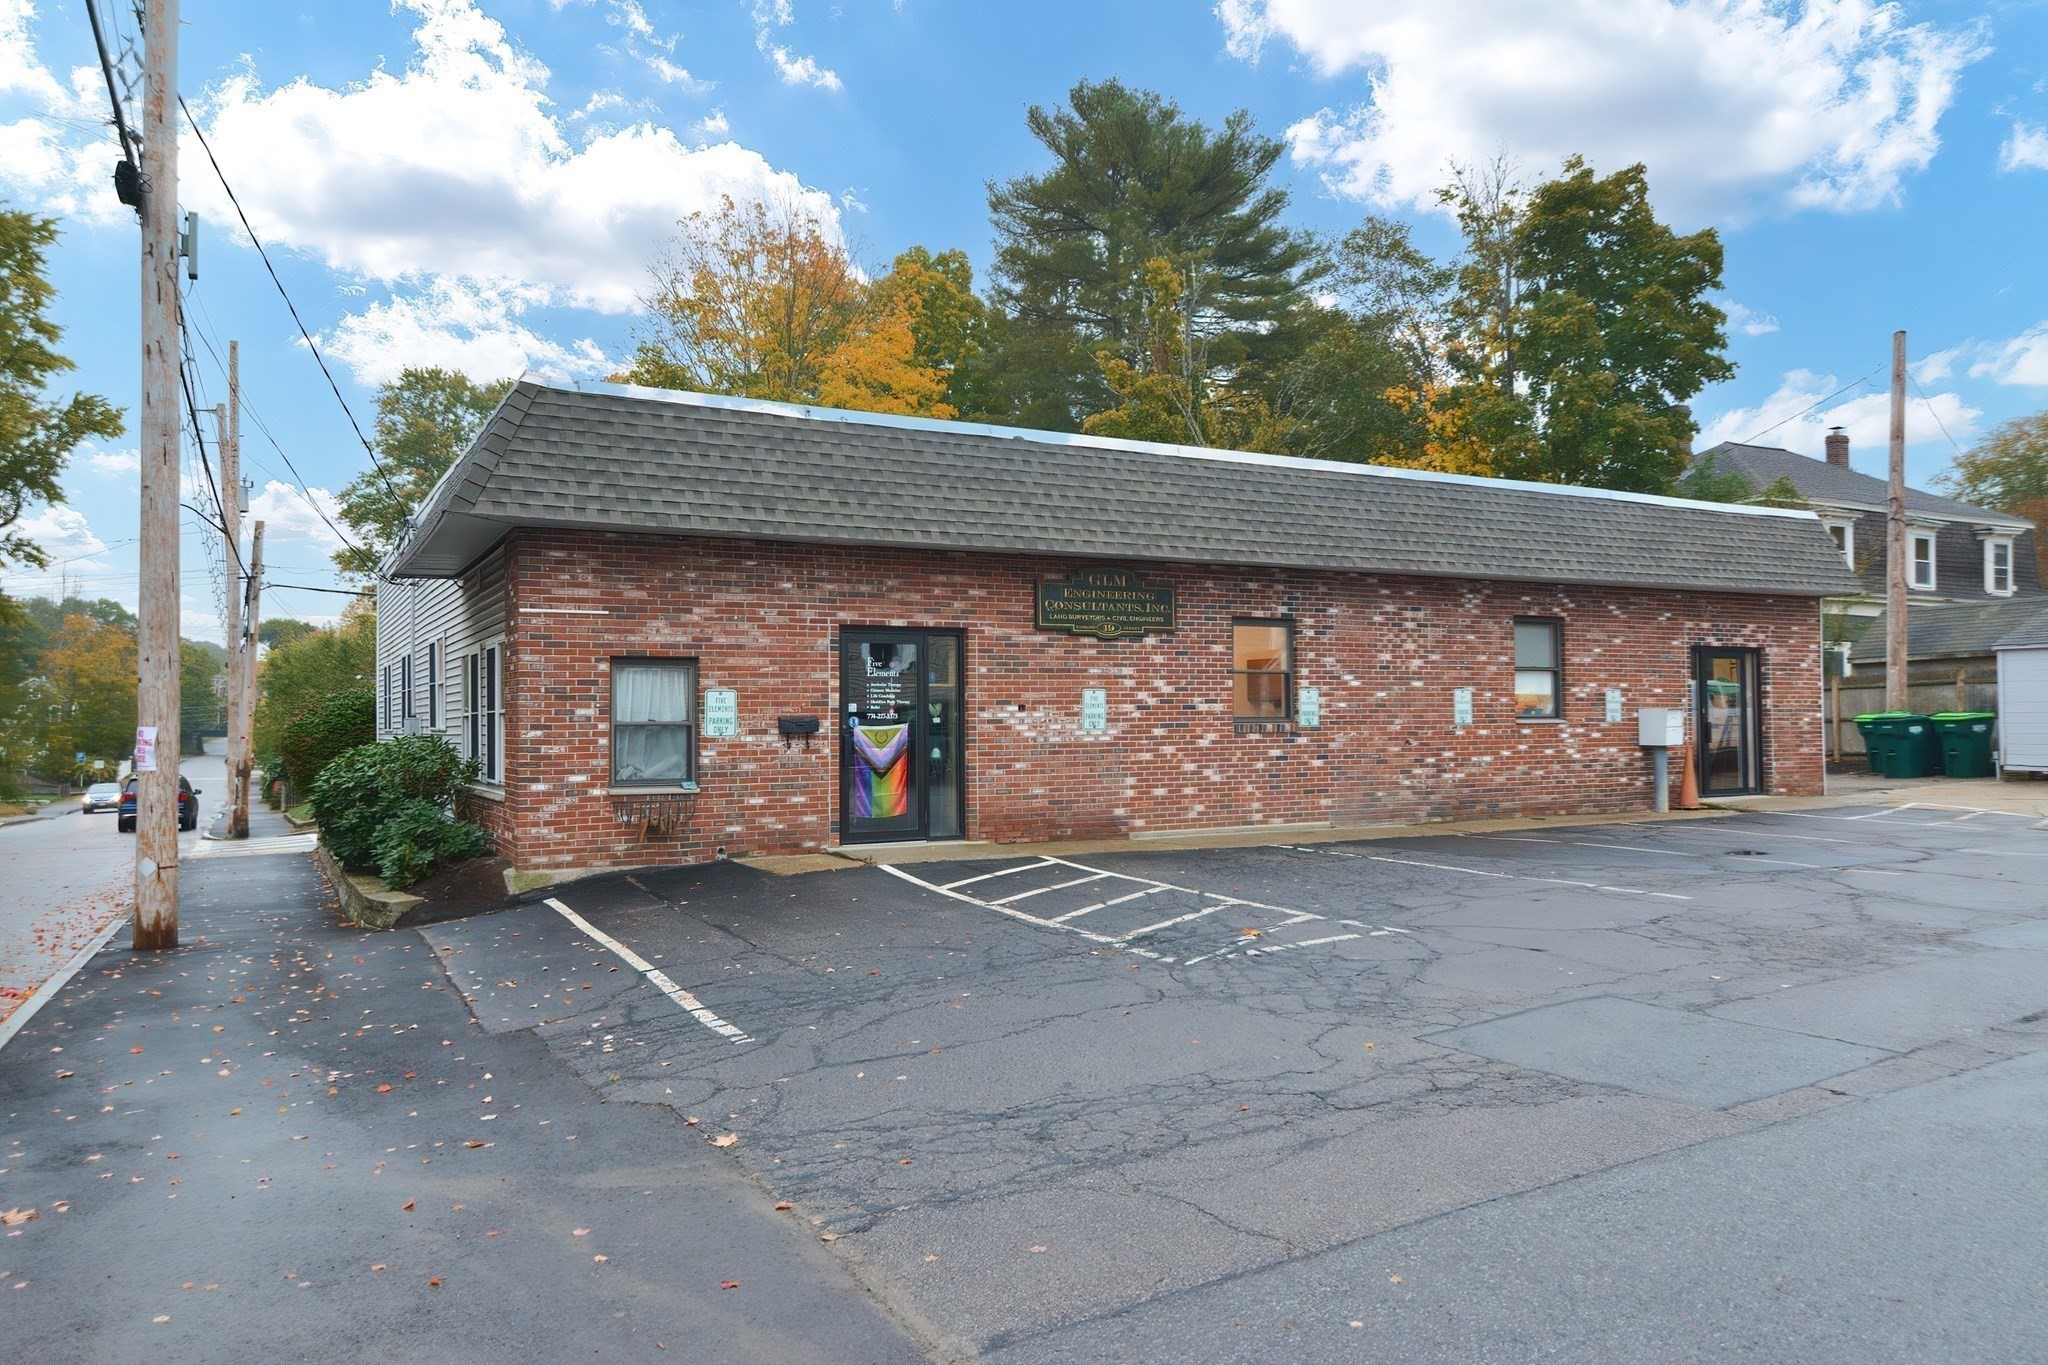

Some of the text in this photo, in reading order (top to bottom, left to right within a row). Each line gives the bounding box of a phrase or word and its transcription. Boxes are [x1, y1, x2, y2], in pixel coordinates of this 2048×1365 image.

[1088, 575, 1126, 587] GLM
[1064, 588, 1156, 600] ENGINEERING
[1146, 603, 1171, 613] INC.
[1104, 624, 1115, 632] 19
[866, 657, 883, 668] Five
[866, 667, 900, 677] Elements
[708, 717, 734, 725] PARKING
[713, 726, 729, 734] ONLY
